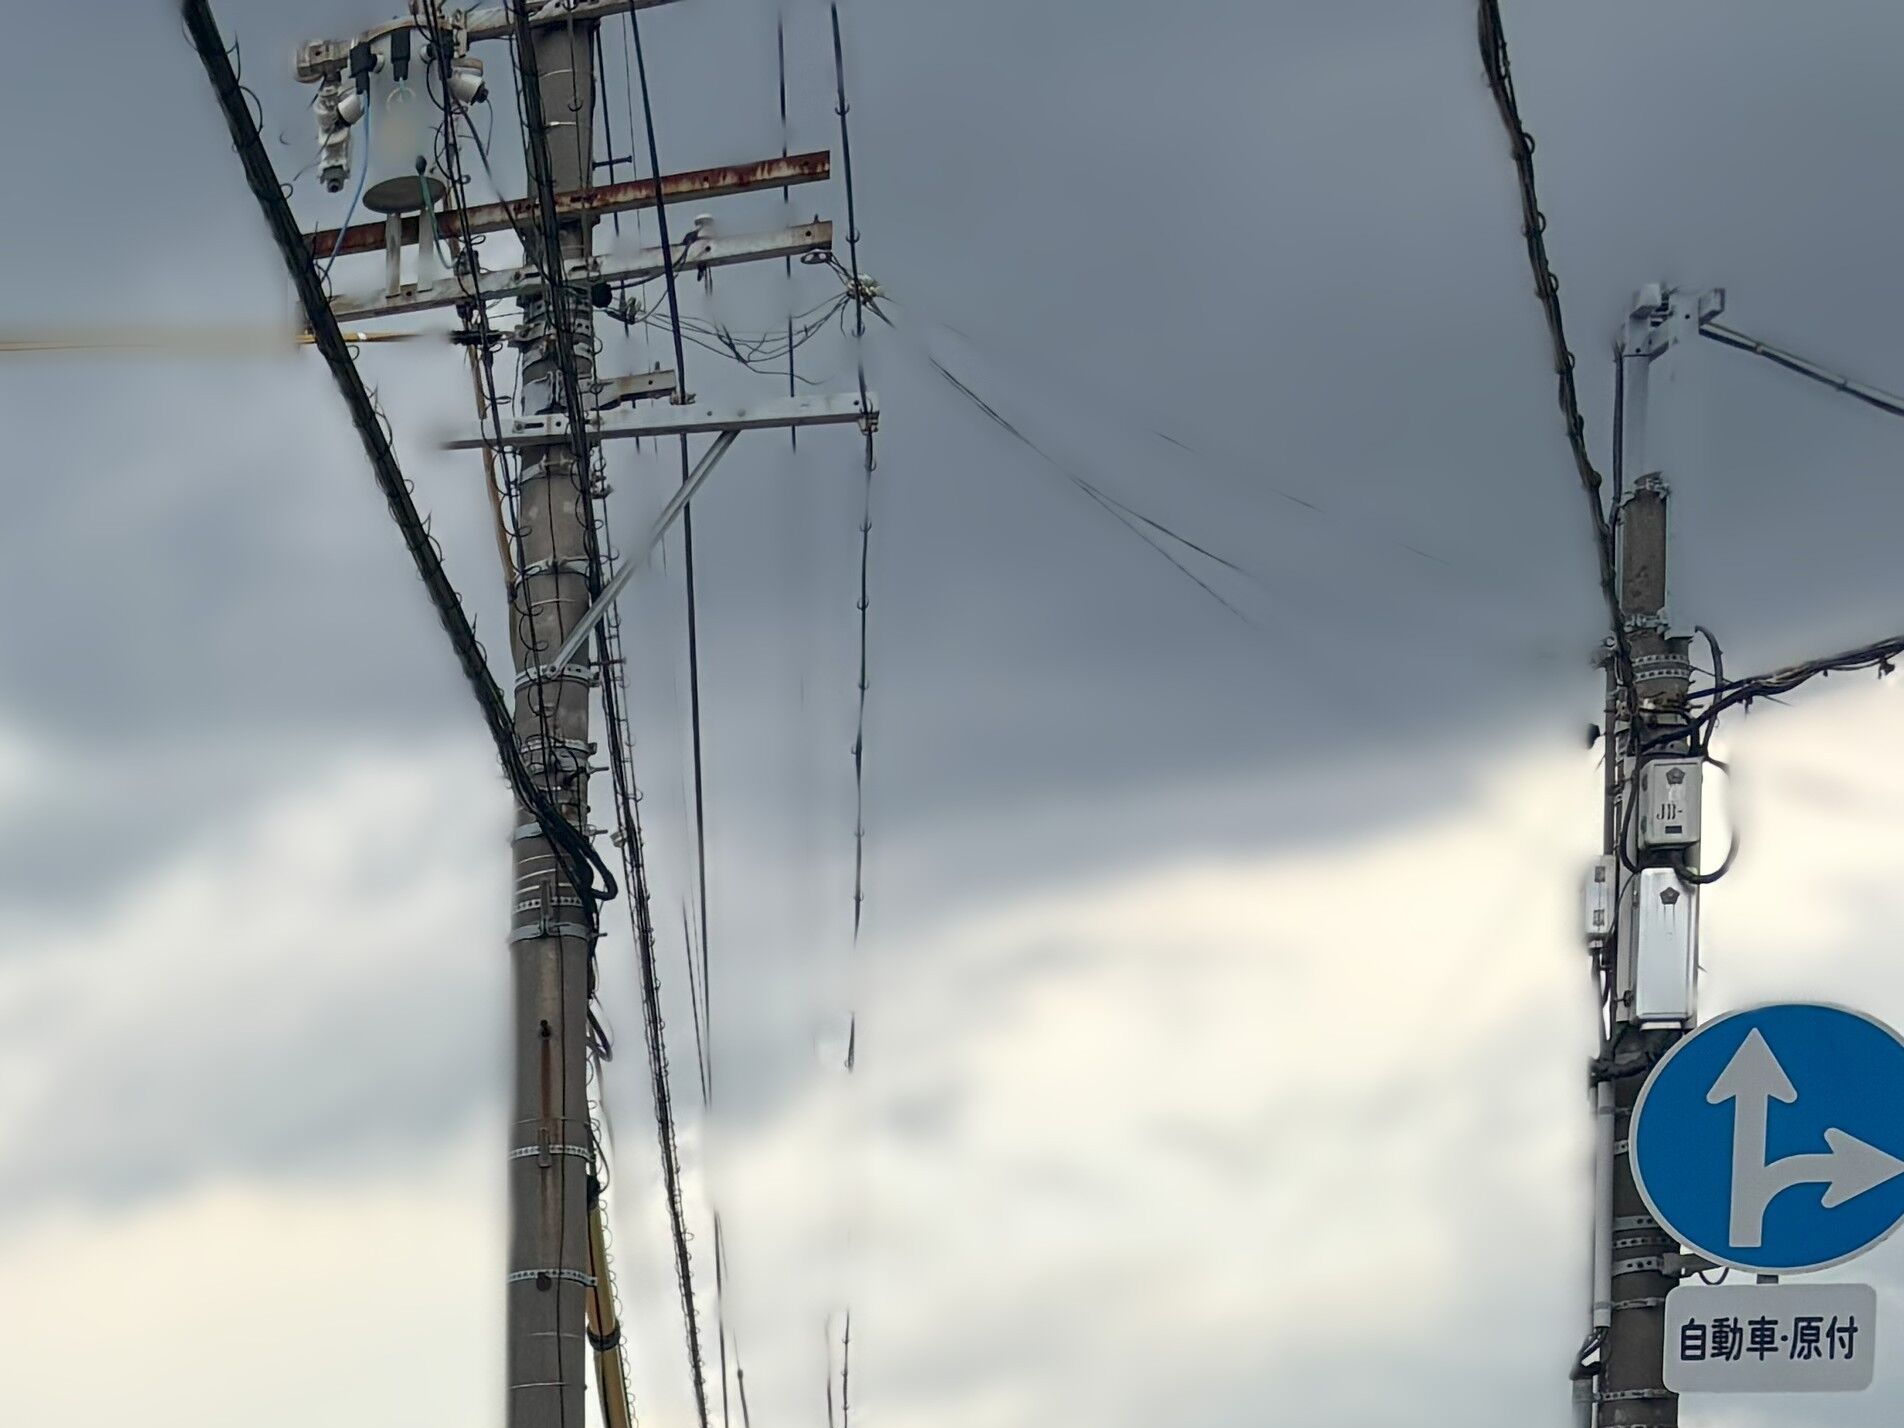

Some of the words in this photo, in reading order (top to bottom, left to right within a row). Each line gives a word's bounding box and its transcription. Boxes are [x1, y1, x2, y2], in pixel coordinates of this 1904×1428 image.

[1680, 1315, 1859, 1361] 自動車・原付
